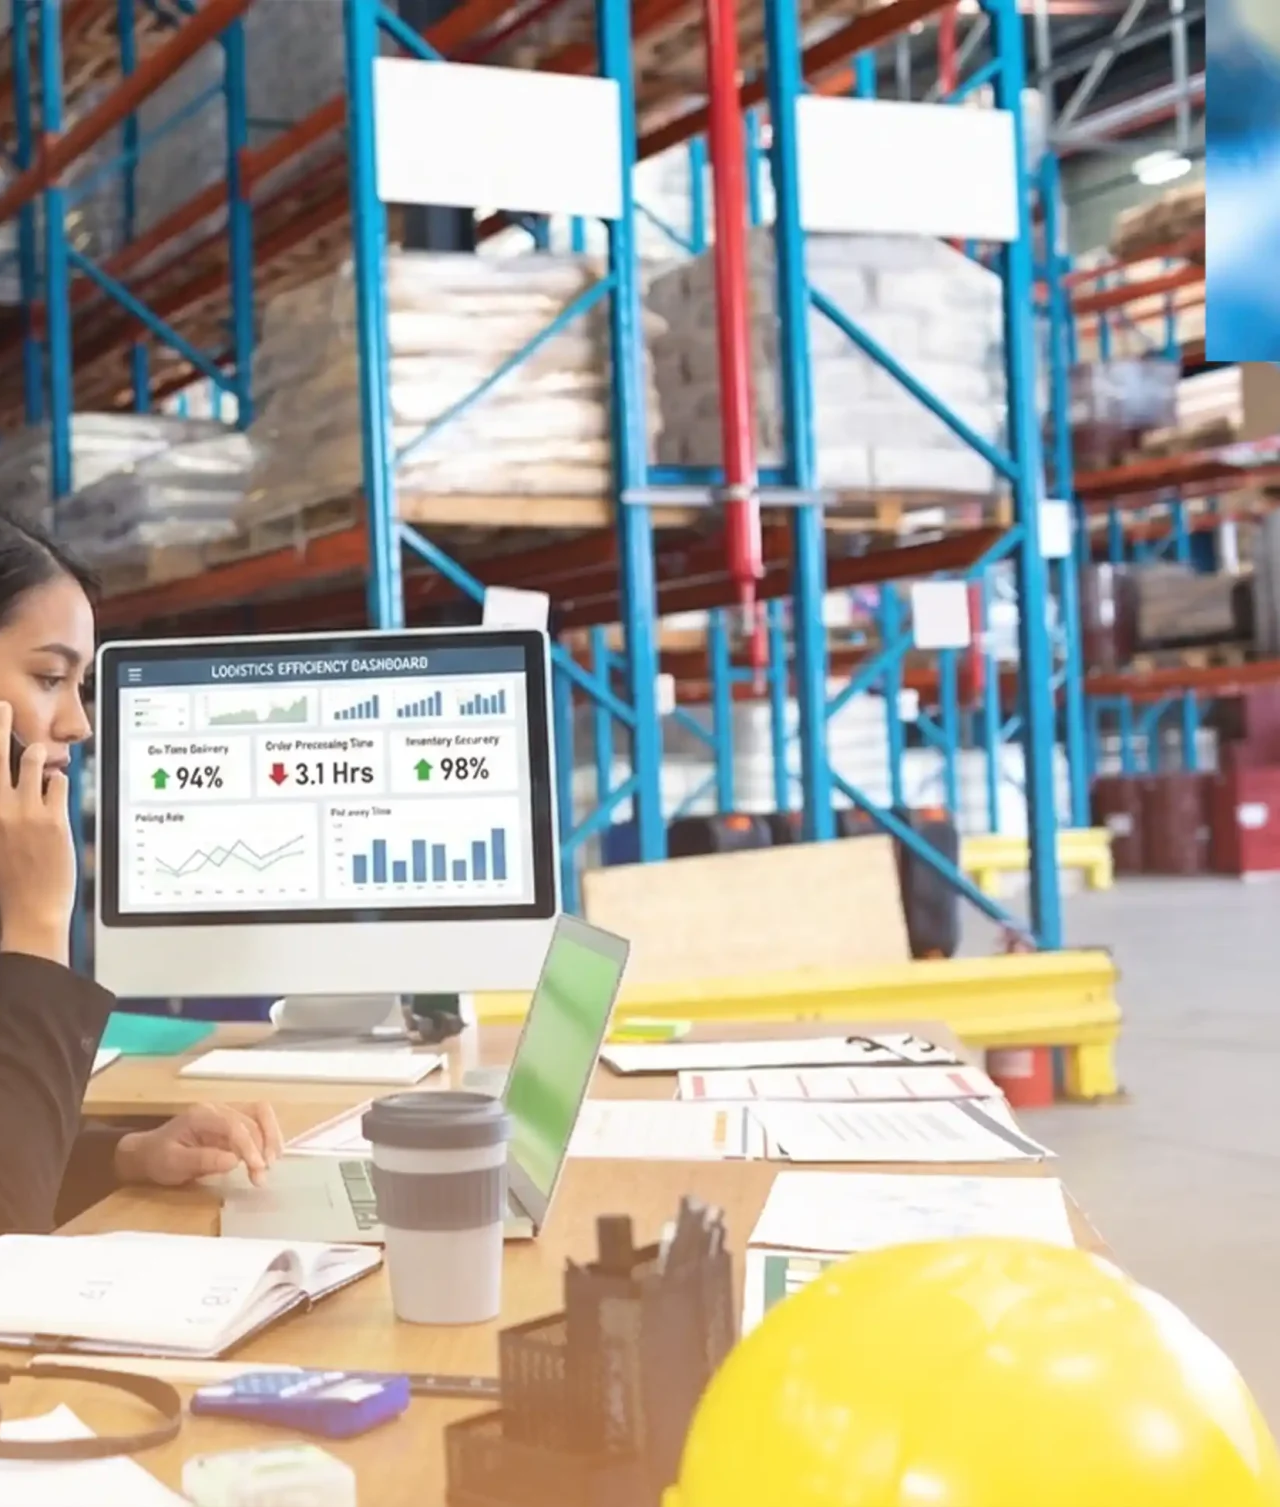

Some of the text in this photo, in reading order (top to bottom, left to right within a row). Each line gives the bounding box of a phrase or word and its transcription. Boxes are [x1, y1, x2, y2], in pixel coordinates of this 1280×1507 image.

[277, 659, 349, 676] EFFICIENCY
[176, 765, 224, 790] 94%
[295, 761, 375, 786] 3.1 Hrs
[440, 756, 490, 781] 98%
